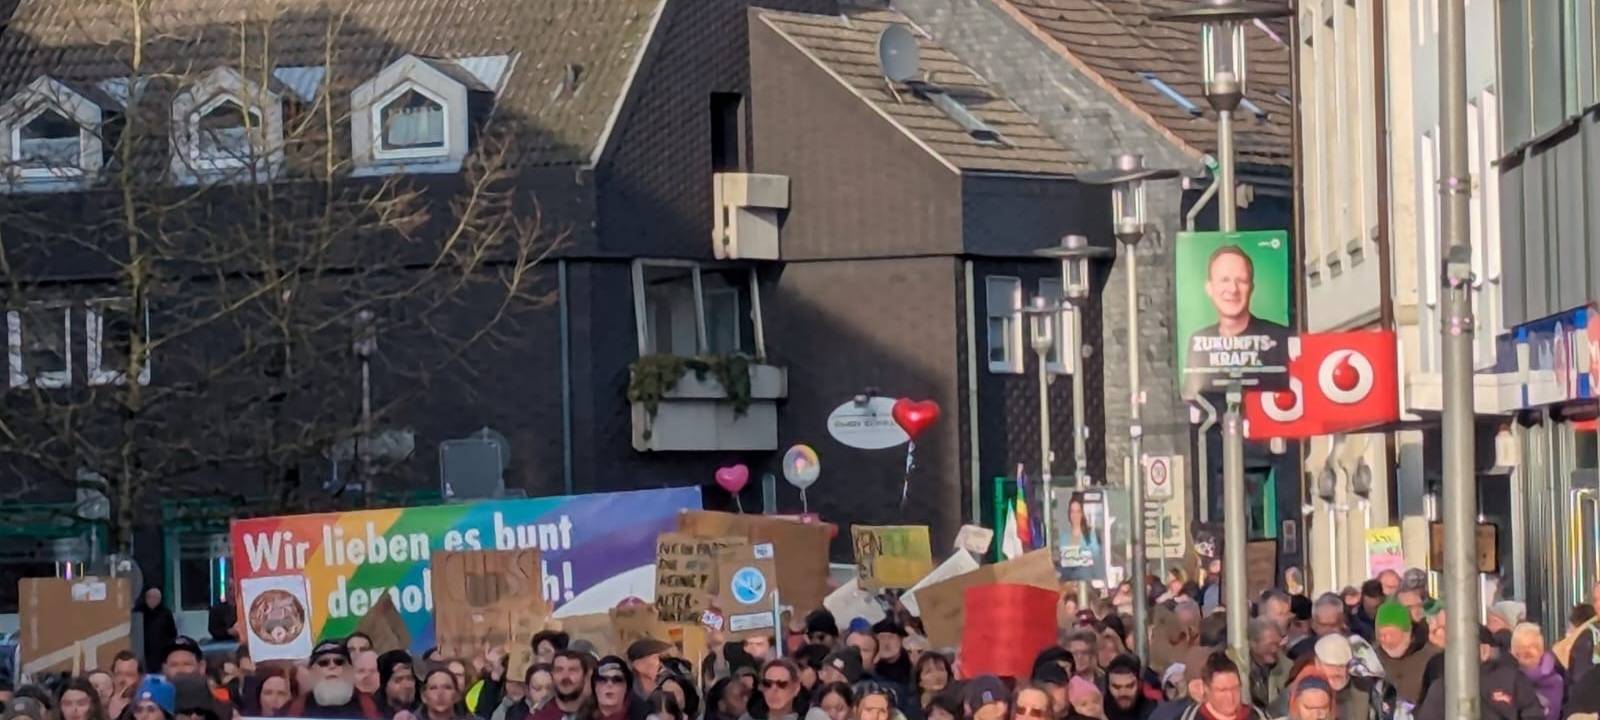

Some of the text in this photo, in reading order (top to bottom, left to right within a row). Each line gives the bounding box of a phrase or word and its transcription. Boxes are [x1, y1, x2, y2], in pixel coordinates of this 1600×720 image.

[1192, 335, 1278, 352] ZUKUNFTS-
[1209, 351, 1264, 367] KRAFT.
[243, 511, 573, 573] Wir lieben es bunt
